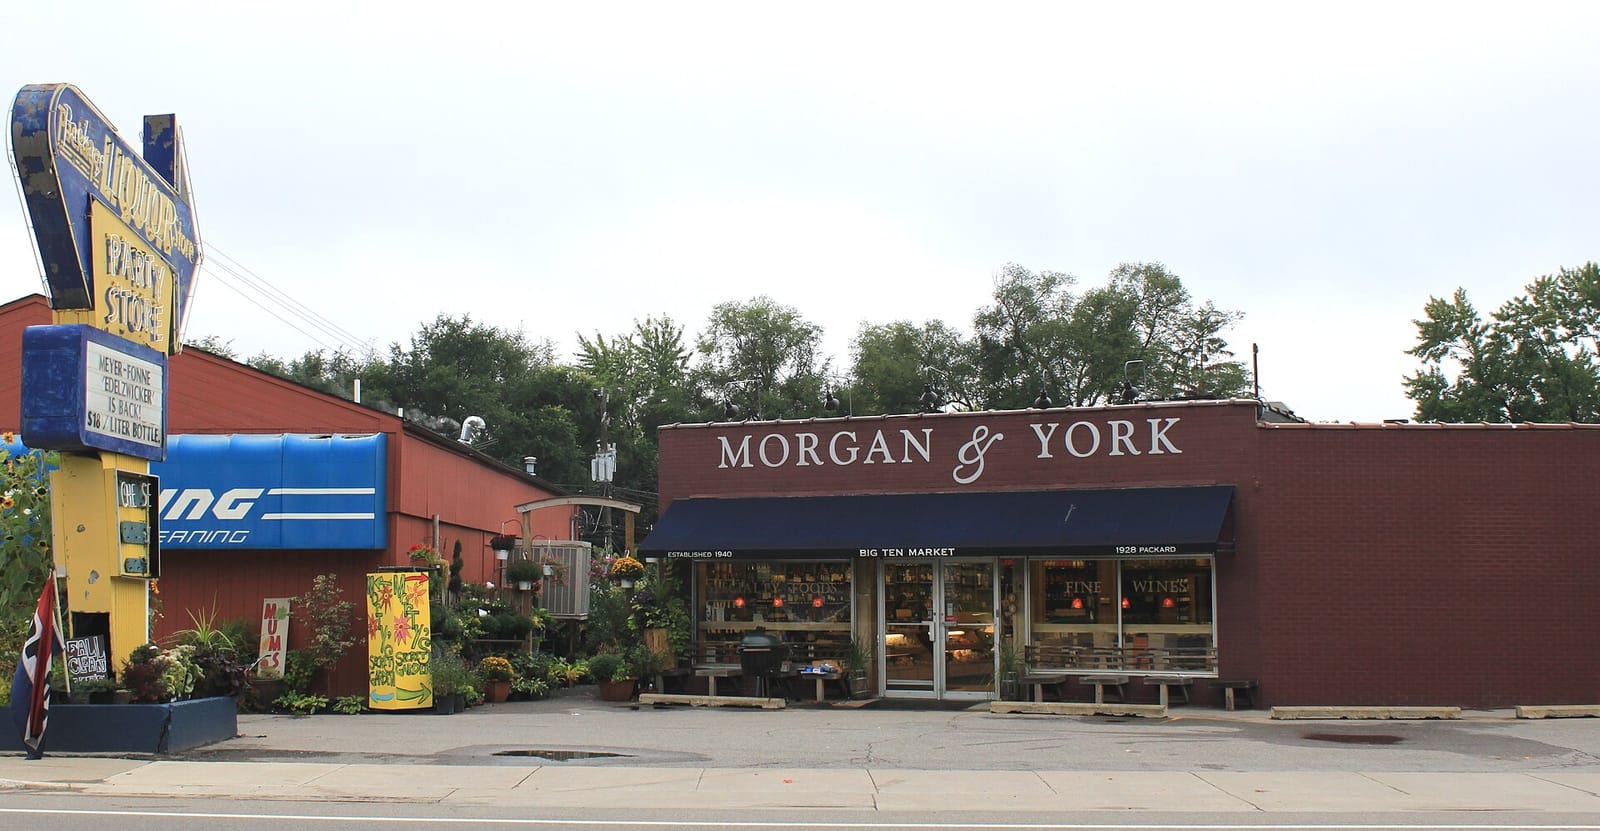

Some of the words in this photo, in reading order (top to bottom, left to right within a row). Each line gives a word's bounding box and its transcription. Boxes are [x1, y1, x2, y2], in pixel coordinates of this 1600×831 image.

[100, 134, 178, 256] LIQUOR
[105, 234, 166, 306] PARTY
[104, 287, 164, 342] STORE
[99, 354, 151, 386] MEYER-FONNE
[108, 396, 116, 413] IS
[119, 401, 142, 421] BACK!
[87, 410, 101, 429] $18
[110, 416, 130, 436] LITER
[132, 422, 161, 443] BOTTLE.
[717, 428, 934, 469] MORGAN
[952, 425, 1004, 484] &
[1030, 417, 1183, 459] YORK
[159, 488, 265, 520] ING
[159, 530, 250, 543] EANING
[1115, 546, 1137, 554] 1928
[714, 550, 732, 558] 1940
[859, 549, 878, 557] BIG
[881, 548, 904, 557] TEN
[908, 547, 955, 557] MARKET
[790, 582, 838, 595] FOODS
[1066, 581, 1102, 593] FINE
[1132, 580, 1188, 593] WINES
[66, 636, 105, 659] FALL
[264, 603, 281, 669] MUMS
